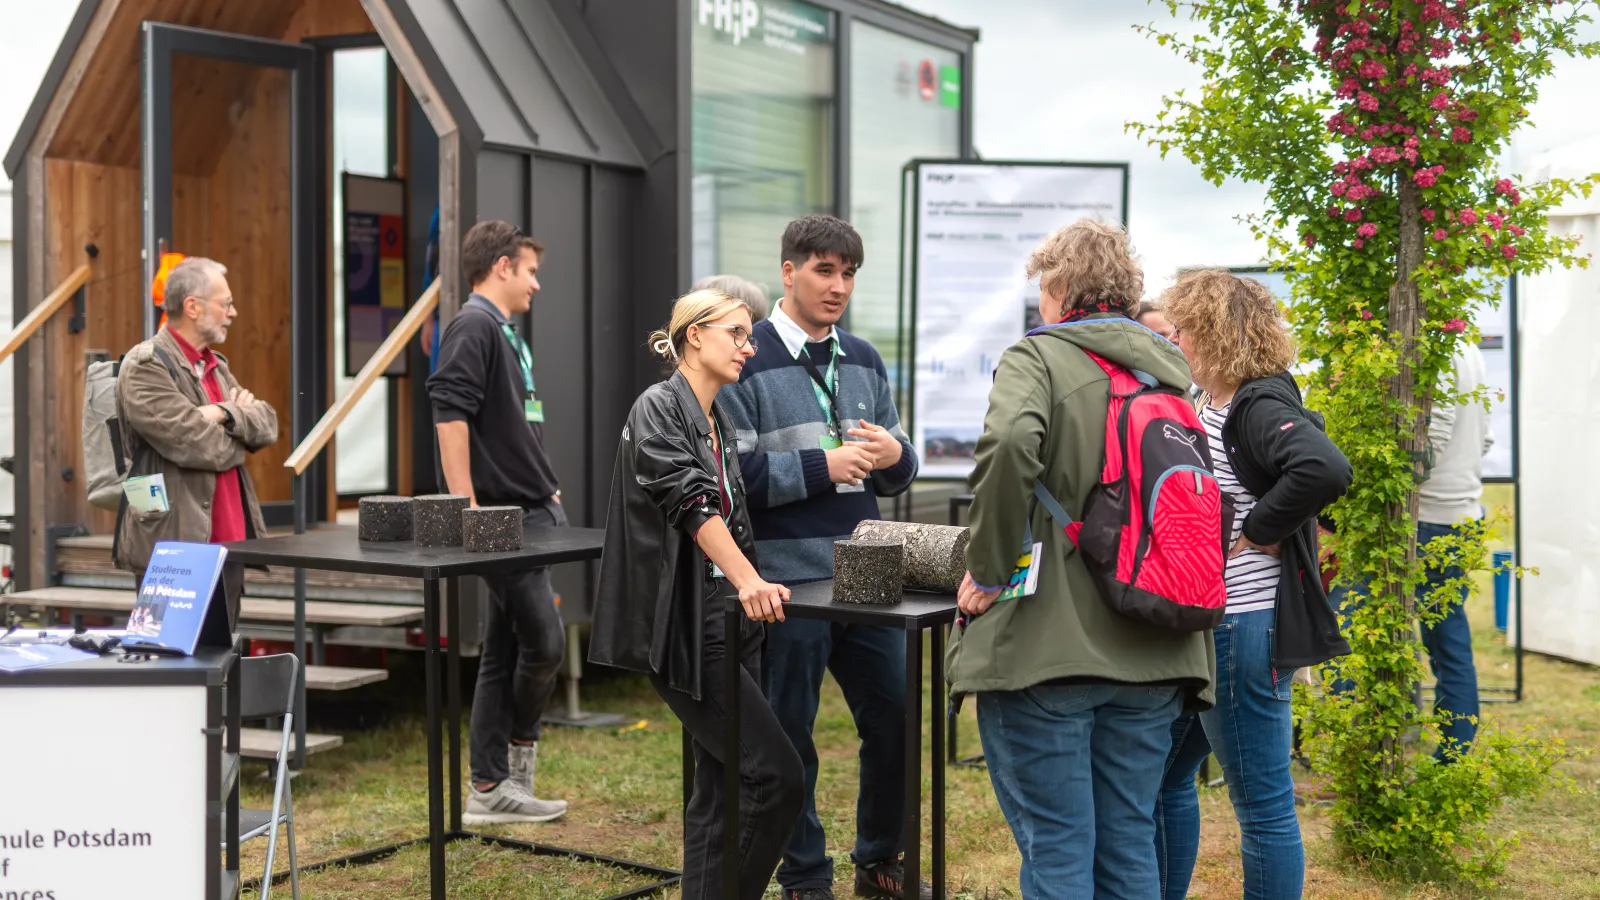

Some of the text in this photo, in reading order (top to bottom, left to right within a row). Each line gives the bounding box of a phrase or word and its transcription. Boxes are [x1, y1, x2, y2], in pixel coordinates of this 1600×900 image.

[150, 565, 192, 577] Studieren
[159, 576, 175, 585] der
[143, 585, 197, 599] FH Potsdam
[53, 828, 152, 848] Potsdam
[0, 890, 56, 900] nces
